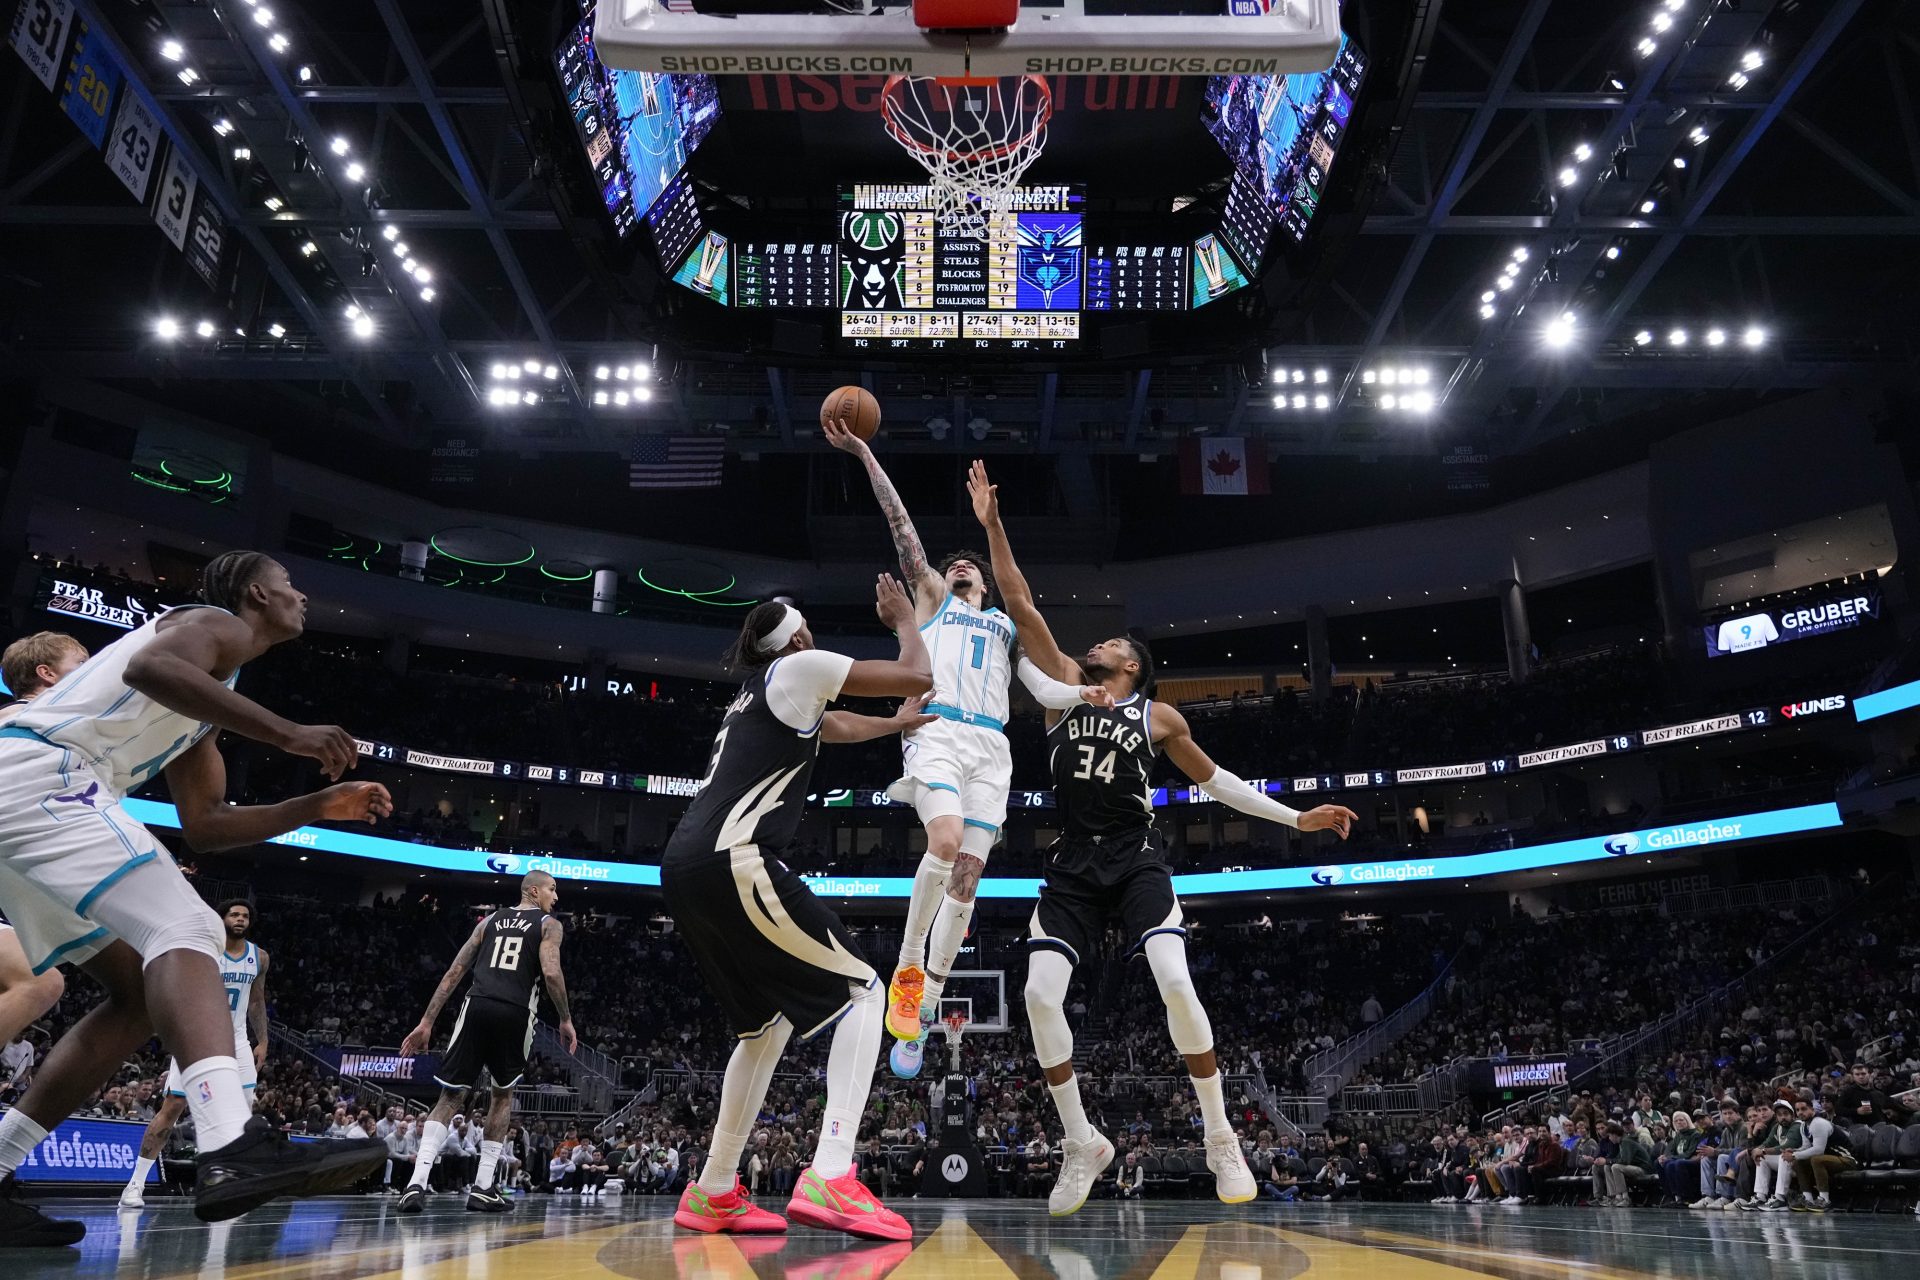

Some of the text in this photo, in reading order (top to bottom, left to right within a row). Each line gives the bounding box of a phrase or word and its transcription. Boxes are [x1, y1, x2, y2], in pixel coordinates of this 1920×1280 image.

[1235, 2, 1256, 14] NBA
[28, 0, 63, 62] 31
[661, 56, 912, 72] SHOP.BUCKS.COM
[1026, 58, 1278, 73] SHOP.BUCKS.COM
[79, 64, 109, 116] 20
[585, 116, 597, 134] 69
[1324, 120, 1336, 140] 76
[121, 124, 150, 173] 43
[601, 161, 613, 180] 76
[1309, 166, 1320, 185] 69
[168, 175, 187, 220] 3
[876, 192, 922, 203] BUCKS
[917, 215, 922, 223] 2
[914, 227, 926, 237] 14
[939, 229, 958, 238] DEF
[195, 215, 221, 264] 22
[765, 244, 832, 255] PTS REB AST FLS
[914, 242, 925, 251] 18
[943, 243, 981, 252] ASSISTS
[998, 243, 1009, 251] 19
[1116, 246, 1182, 257] PTS REB AST FLS
[917, 256, 922, 265] 4
[943, 258, 980, 266] STEALS
[1000, 257, 1006, 266] 7
[917, 270, 921, 278] 1
[942, 270, 981, 278] BLOCKS
[1001, 270, 1005, 278] 1
[917, 283, 922, 291] 8
[936, 284, 986, 292] PTS FROM TOV
[998, 283, 1008, 292] 19
[917, 297, 921, 305] 1
[936, 297, 986, 306] CHALLENGES
[1001, 297, 1004, 306] 1
[846, 316, 1076, 325] 26-40 9-18 8-11 27-49 9-23 13-15
[976, 340, 988, 348] FG
[1011, 340, 1029, 348] 3PT
[447, 439, 466, 448] NEED
[51, 580, 104, 605] FEAR
[48, 595, 134, 625] The DEER
[1781, 597, 1870, 629] GRUBER
[1814, 620, 1843, 630] OFFICES
[1740, 625, 1752, 640] 9
[971, 634, 986, 670] 1
[1791, 695, 1845, 716] KUNES
[1645, 711, 1765, 743] FAST BREAK PTS 12
[1067, 716, 1144, 753] BUCKS
[378, 746, 393, 759] 21
[1521, 737, 1628, 766] BENCH POINTS 18
[408, 754, 512, 775] POINTS FROM TOV 8
[1073, 744, 1117, 784] 34
[1399, 760, 1505, 780] POINTS FROM TOV 19
[530, 768, 567, 780] TOL 5
[582, 774, 617, 785] FLS 1
[1346, 772, 1383, 786] TOL 5
[1296, 777, 1330, 789] FLS 1
[872, 792, 891, 805] 69
[1023, 792, 1043, 806] 76
[1646, 824, 1742, 848] Gallagher
[527, 859, 610, 880] Gallagher
[1350, 864, 1435, 881] Gallagher
[806, 880, 881, 896] Gallagher
[495, 919, 532, 933] KUZMA
[489, 936, 524, 971] 18
[359, 1061, 397, 1073] BUCKS
[1512, 1070, 1550, 1081] BUCKS
